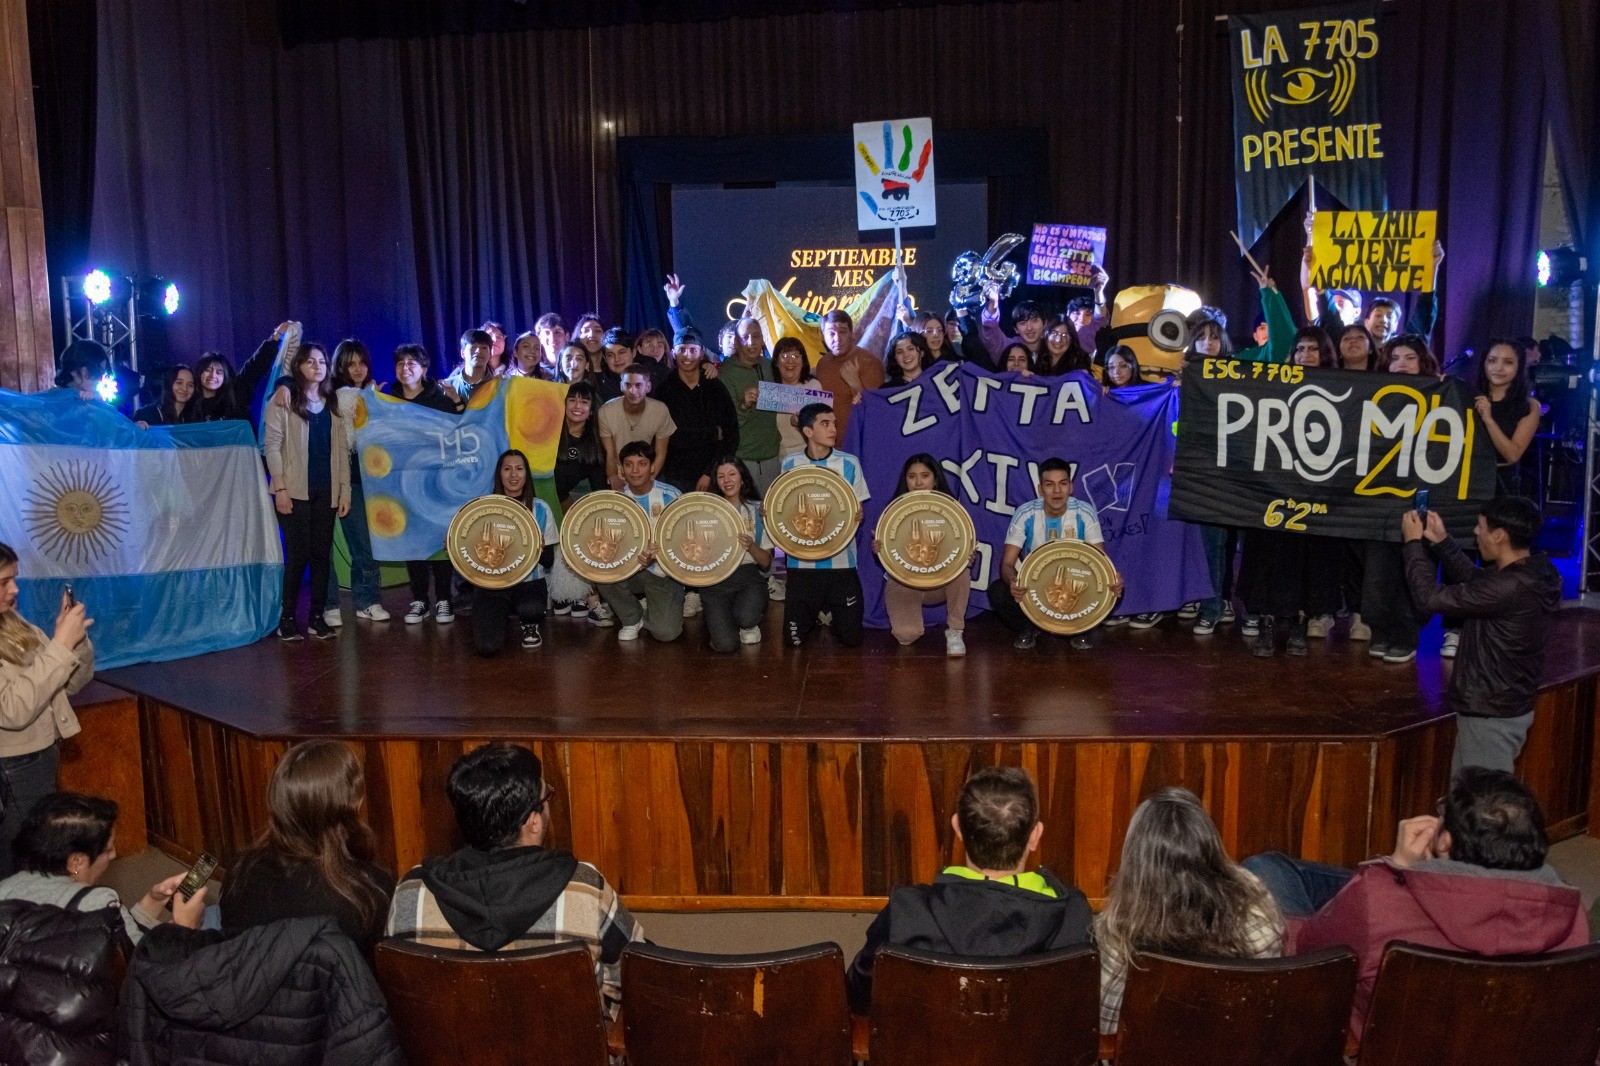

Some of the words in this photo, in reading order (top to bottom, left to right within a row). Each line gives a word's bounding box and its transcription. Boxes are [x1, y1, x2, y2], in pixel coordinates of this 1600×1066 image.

[1240, 25, 1290, 69] LA
[1299, 18, 1379, 60] 7705
[1242, 123, 1384, 172] PRESENTE
[890, 209, 910, 217] 7705
[1329, 211, 1362, 240] LA
[1370, 210, 1426, 240] 7MIL
[1032, 234, 1046, 243] NO
[1035, 225, 1048, 234] NO
[1050, 227, 1060, 235] ES
[1046, 246, 1058, 257] LA
[1332, 238, 1413, 268] TIENE
[1031, 254, 1069, 270] QUIERE
[1070, 262, 1092, 276] SER
[1034, 269, 1091, 286] BICAMPEON
[832, 269, 874, 288] MES
[1311, 264, 1424, 292] AGUANTE
[1203, 358, 1245, 379] ESC.
[1252, 363, 1304, 383] 7705
[804, 389, 833, 398] ZETTA
[1217, 391, 1465, 485] PROMO
[778, 520, 845, 546] INTERCAPITAL
[460, 546, 526, 574] INTERCAPITAL
[574, 544, 638, 569] INTERCAPITAL
[667, 546, 732, 571] INTERCAPITAL
[891, 547, 960, 573] INTERCAPITAL
[1030, 590, 1100, 621] INTERCAPITAL
